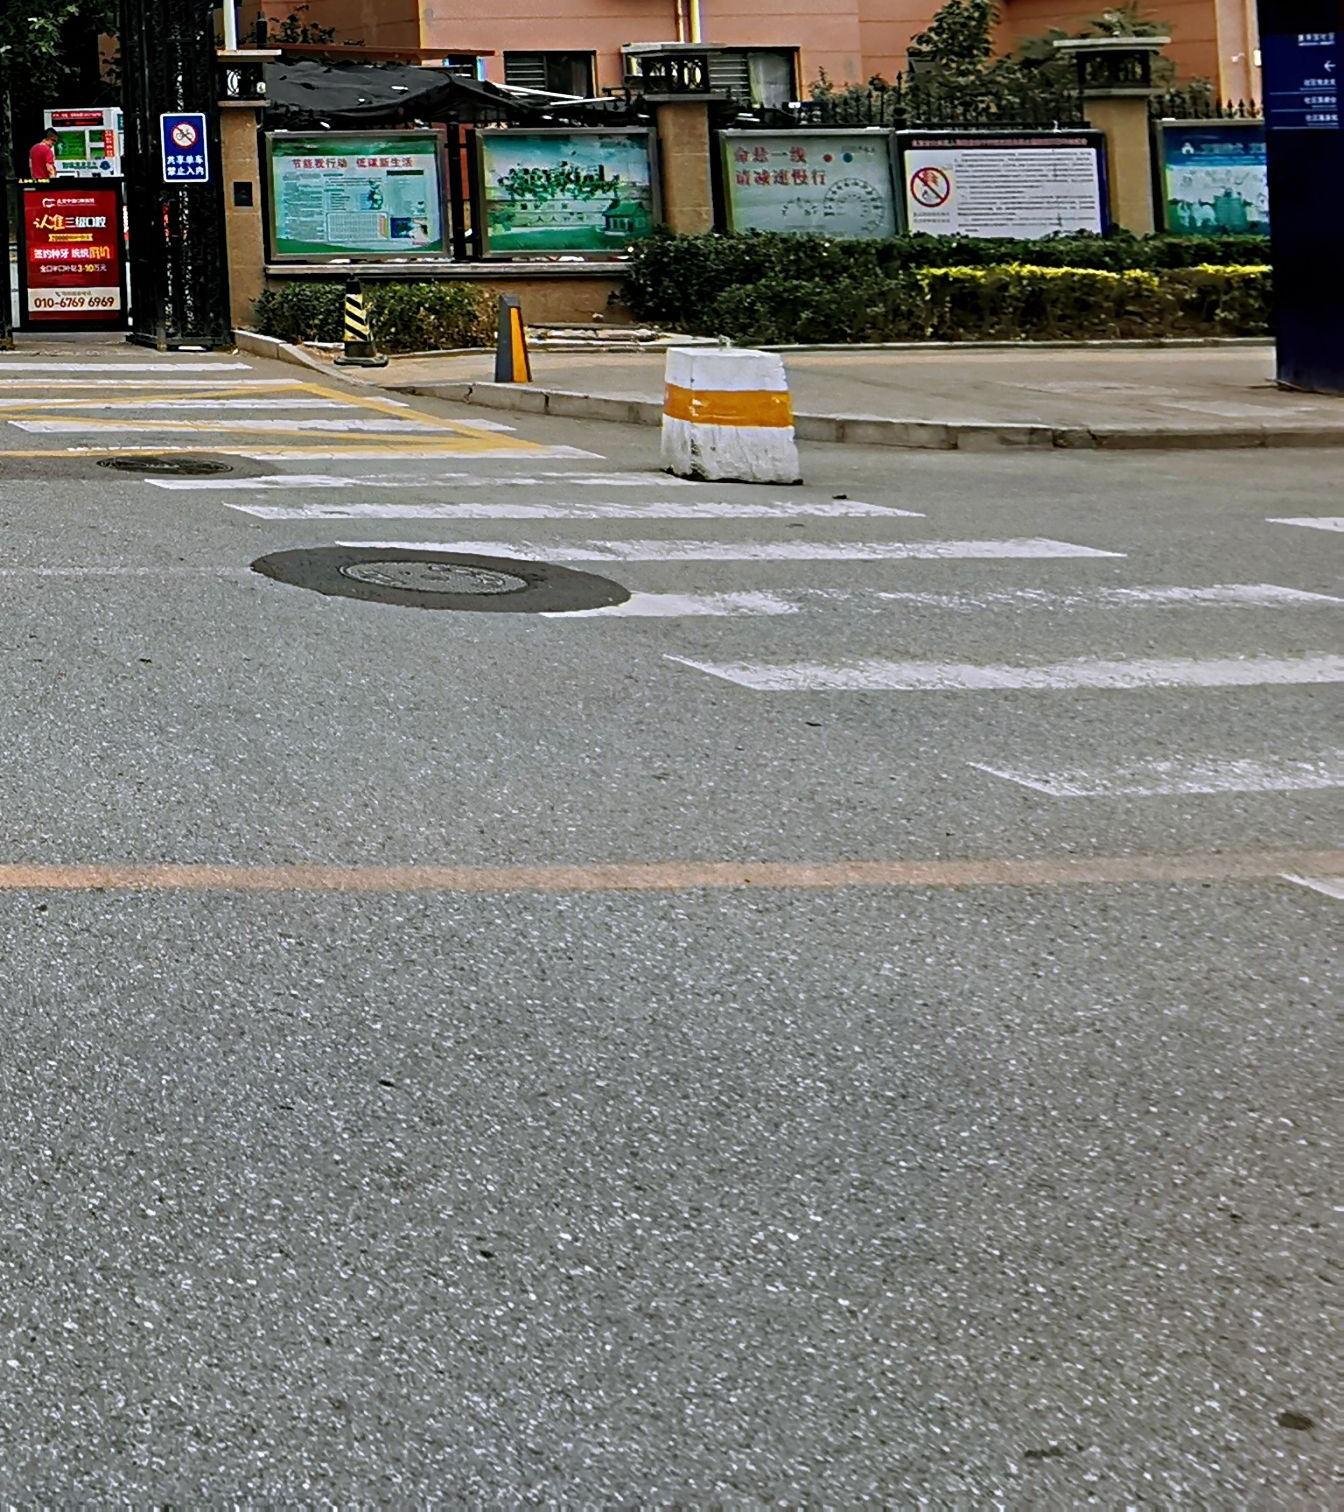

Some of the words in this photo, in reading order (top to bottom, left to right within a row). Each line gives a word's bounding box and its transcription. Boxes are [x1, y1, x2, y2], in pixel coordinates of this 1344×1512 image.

[167, 166, 204, 176] 禁止入内
[736, 169, 827, 186] 请减速慢行
[34, 297, 85, 308] 010-6769
[88, 296, 114, 307] 6969
